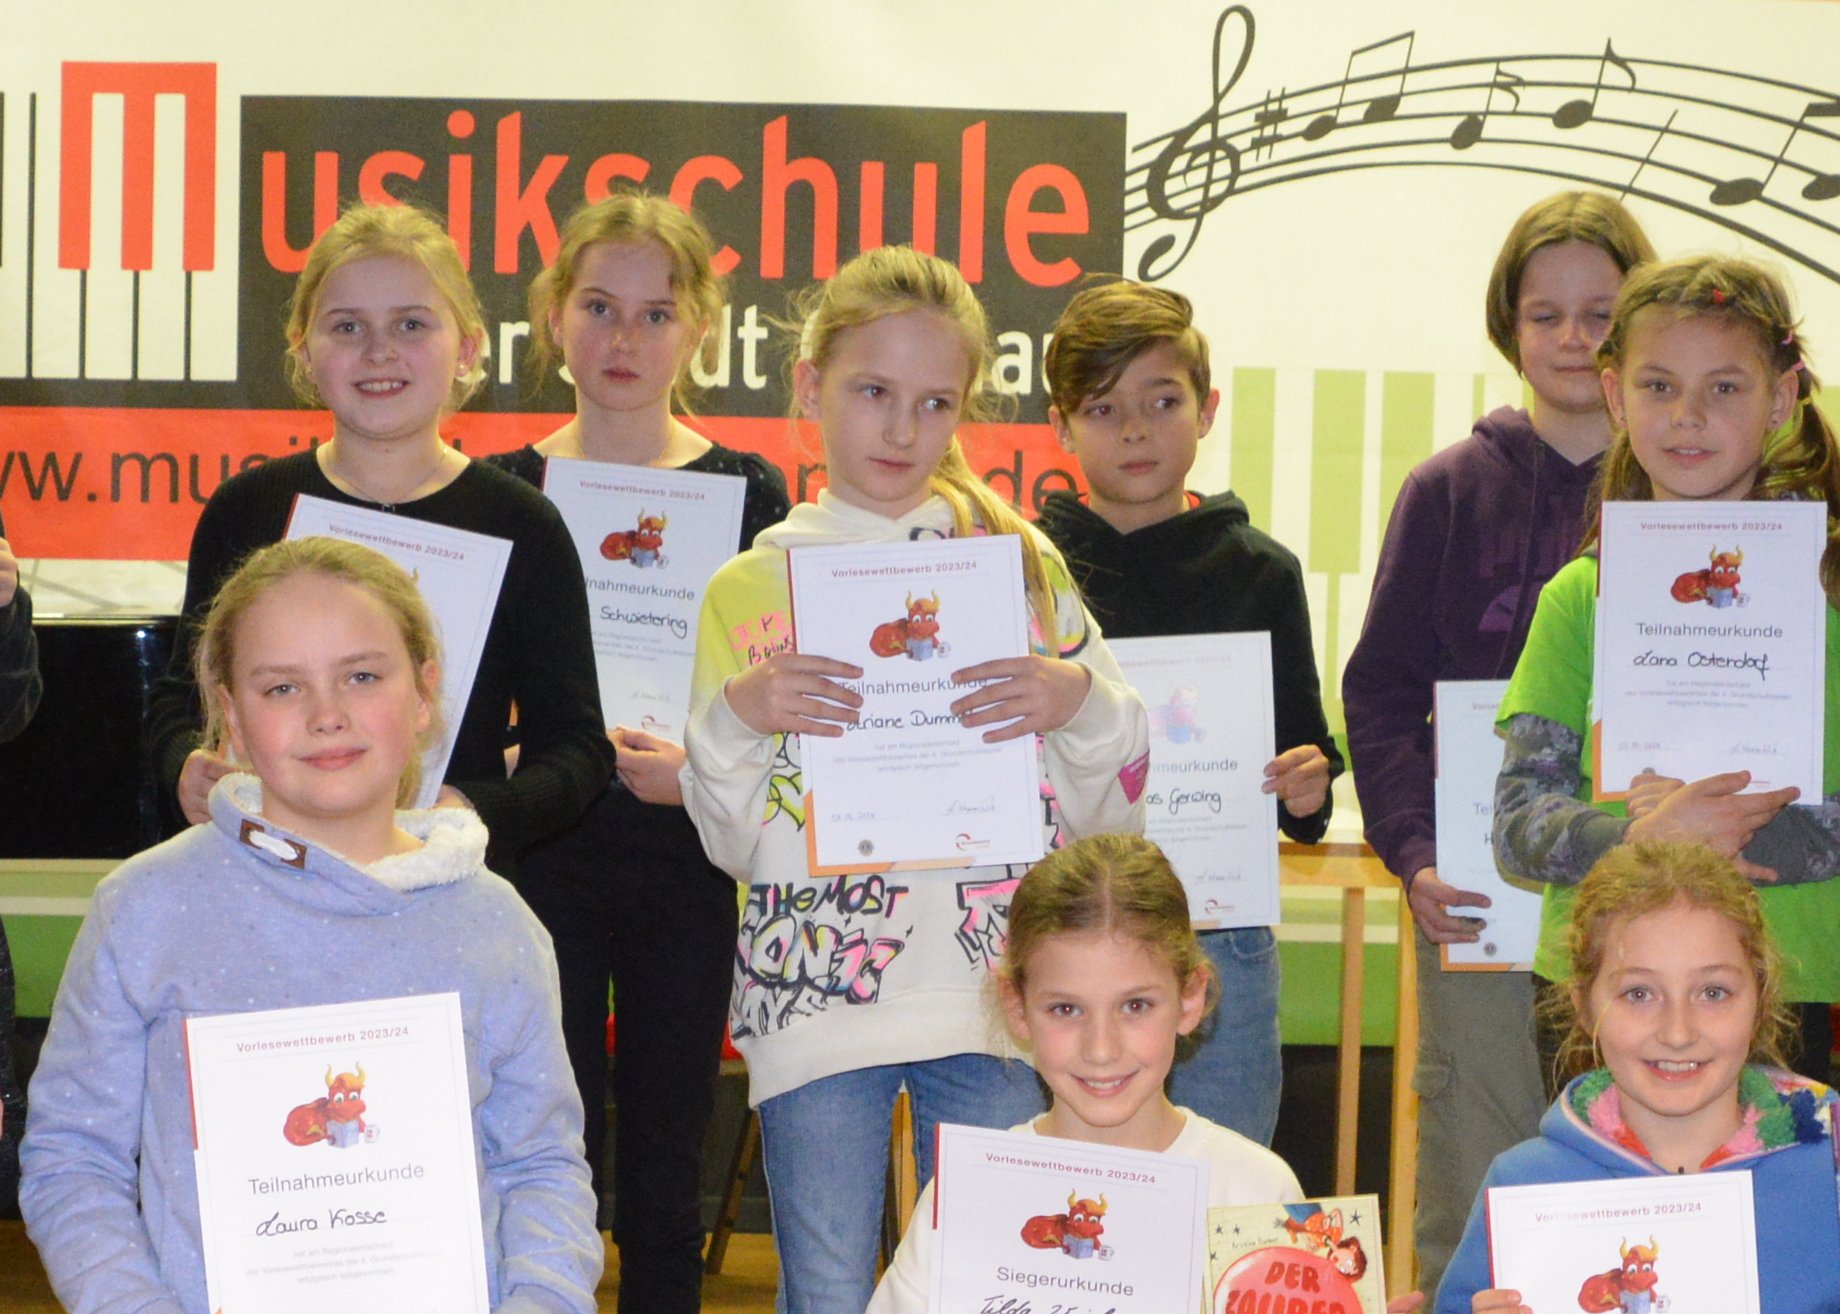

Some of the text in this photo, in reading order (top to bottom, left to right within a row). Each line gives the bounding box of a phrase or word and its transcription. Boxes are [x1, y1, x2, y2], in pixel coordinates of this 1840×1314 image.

[328, 523, 423, 552] Vorlesewettbewerb
[1640, 521, 1783, 531] Vorlesewettbewerb 2023/24
[831, 560, 978, 579] Vorlesewettbewerb 2023/24
[1635, 622, 1784, 639] Teilnahmeurkunde
[1686, 651, 1771, 682] Ostendorf
[235, 1026, 410, 1054] Vorlesewettbewerb 2023/24
[247, 1162, 425, 1196] Teilnahmeurkunde
[985, 1151, 1157, 1185] Vorlesewettbewerb 2023/24
[254, 1207, 388, 1238] Laura Kosse
[1653, 1202, 1703, 1215] 2023/24
[996, 1266, 1135, 1297] Siegerurkunde
[1264, 1260, 1322, 1295] DER
